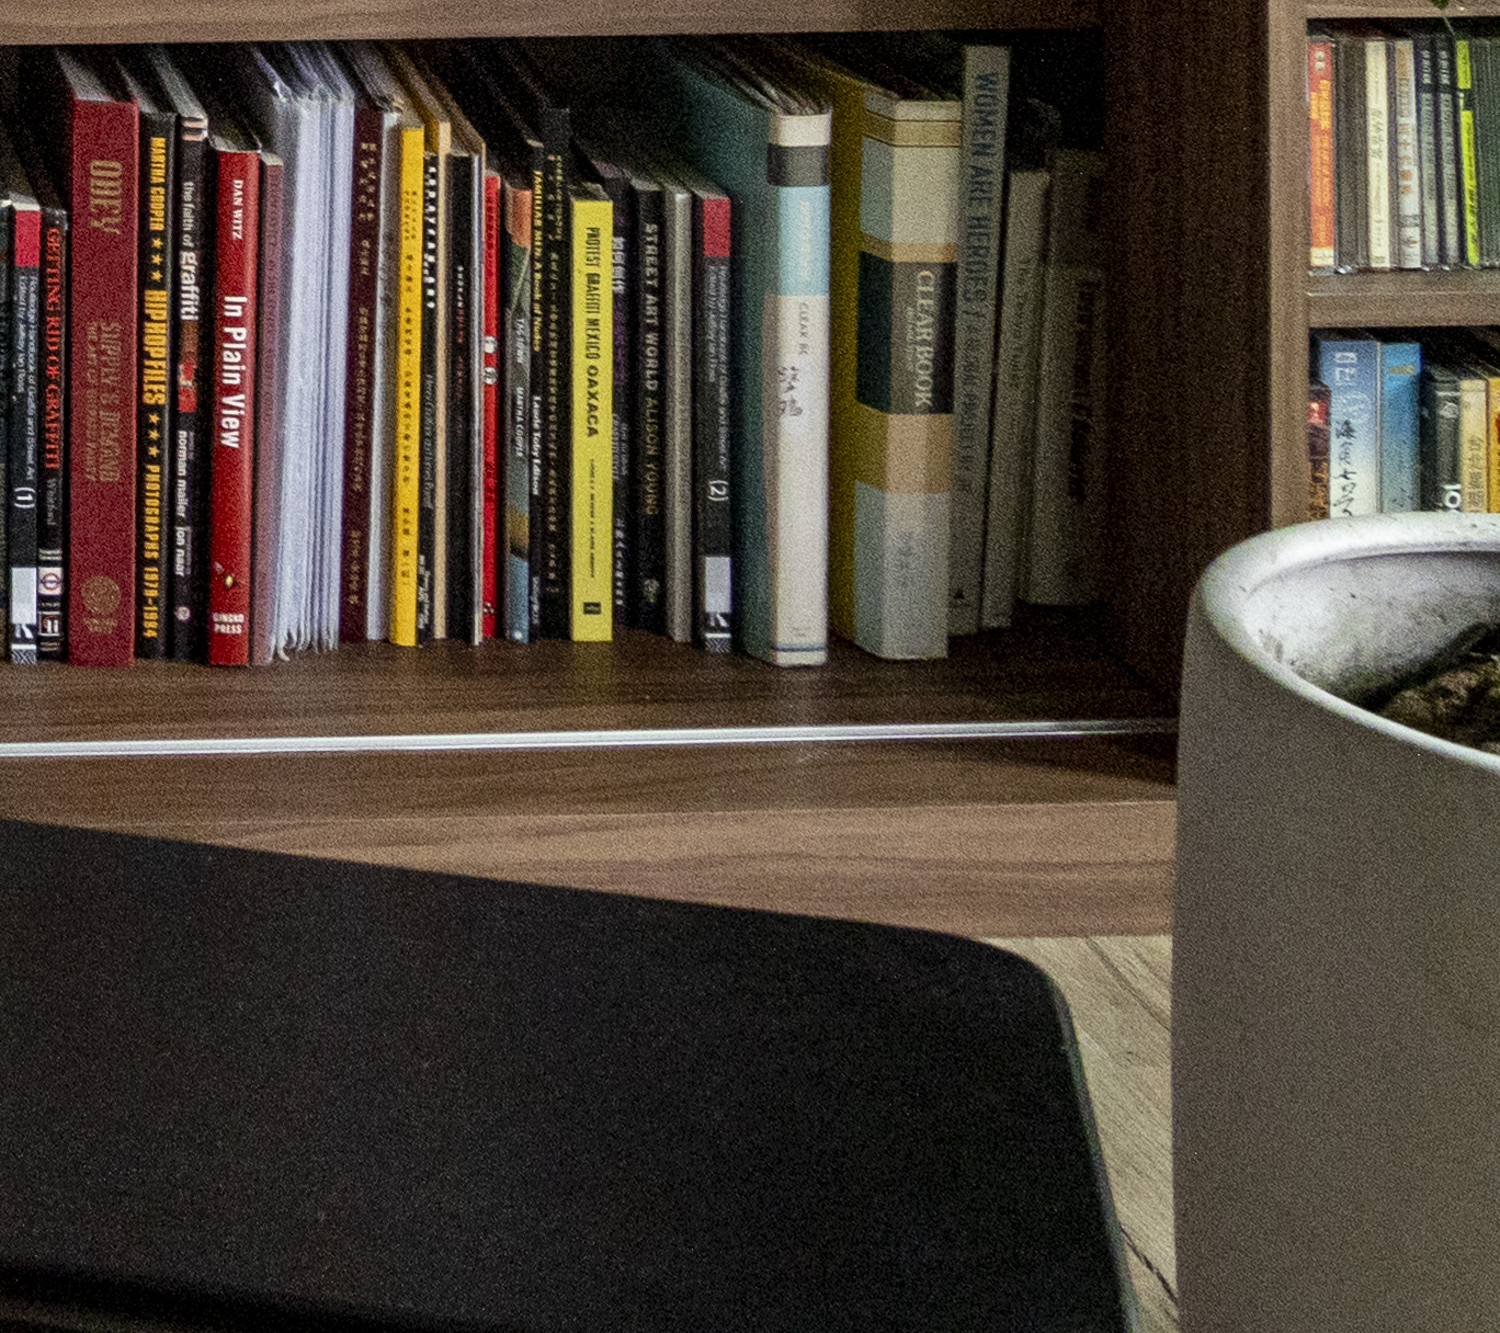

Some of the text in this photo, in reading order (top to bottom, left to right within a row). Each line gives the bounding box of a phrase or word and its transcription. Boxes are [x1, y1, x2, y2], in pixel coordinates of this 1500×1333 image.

[231, 179, 243, 241] DAN WITZ
[43, 227, 60, 471] GETTING RID OF GRAFFITI
[220, 295, 248, 450] In Plain View
[587, 226, 601, 438] PROTEST GRAFFITI MEXICO OAXACA
[645, 223, 660, 515] STREET ART WORLD ALISON YOUNG
[14, 486, 37, 509] (1)
[706, 480, 730, 503] (2)
[214, 623, 243, 635] PRESS
